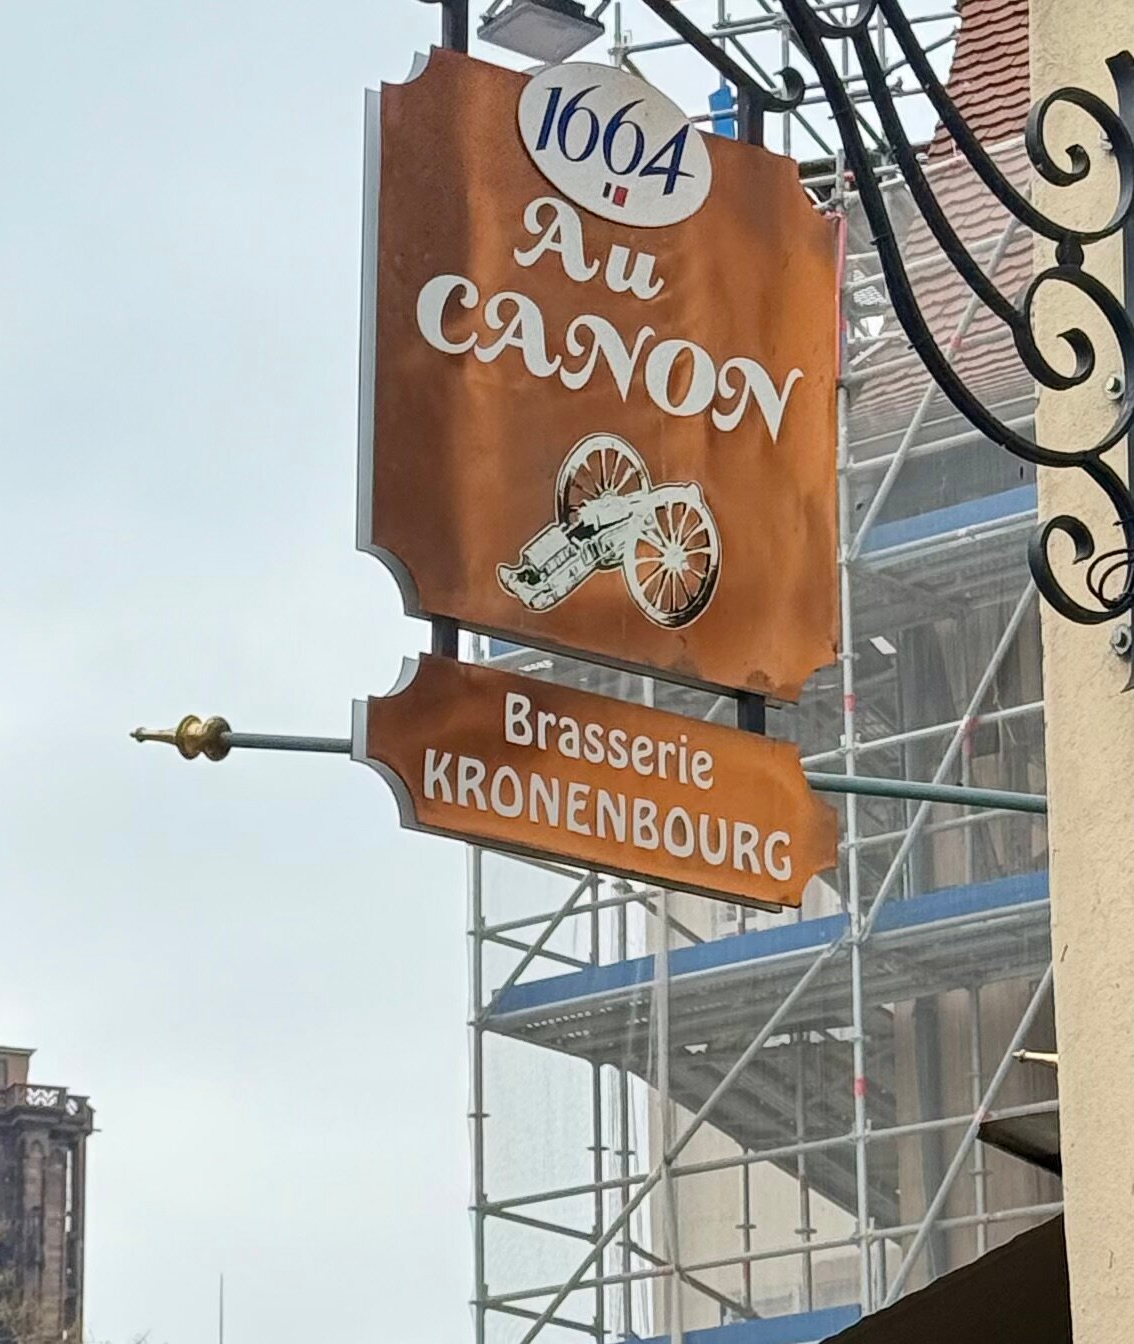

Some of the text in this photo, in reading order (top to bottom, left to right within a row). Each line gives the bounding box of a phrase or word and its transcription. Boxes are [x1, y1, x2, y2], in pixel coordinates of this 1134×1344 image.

[536, 84, 695, 195] 1664
[514, 196, 665, 301] Au
[417, 274, 804, 443] CANON
[504, 692, 714, 790] Brasserie
[423, 749, 792, 882] KRONENBOURG
